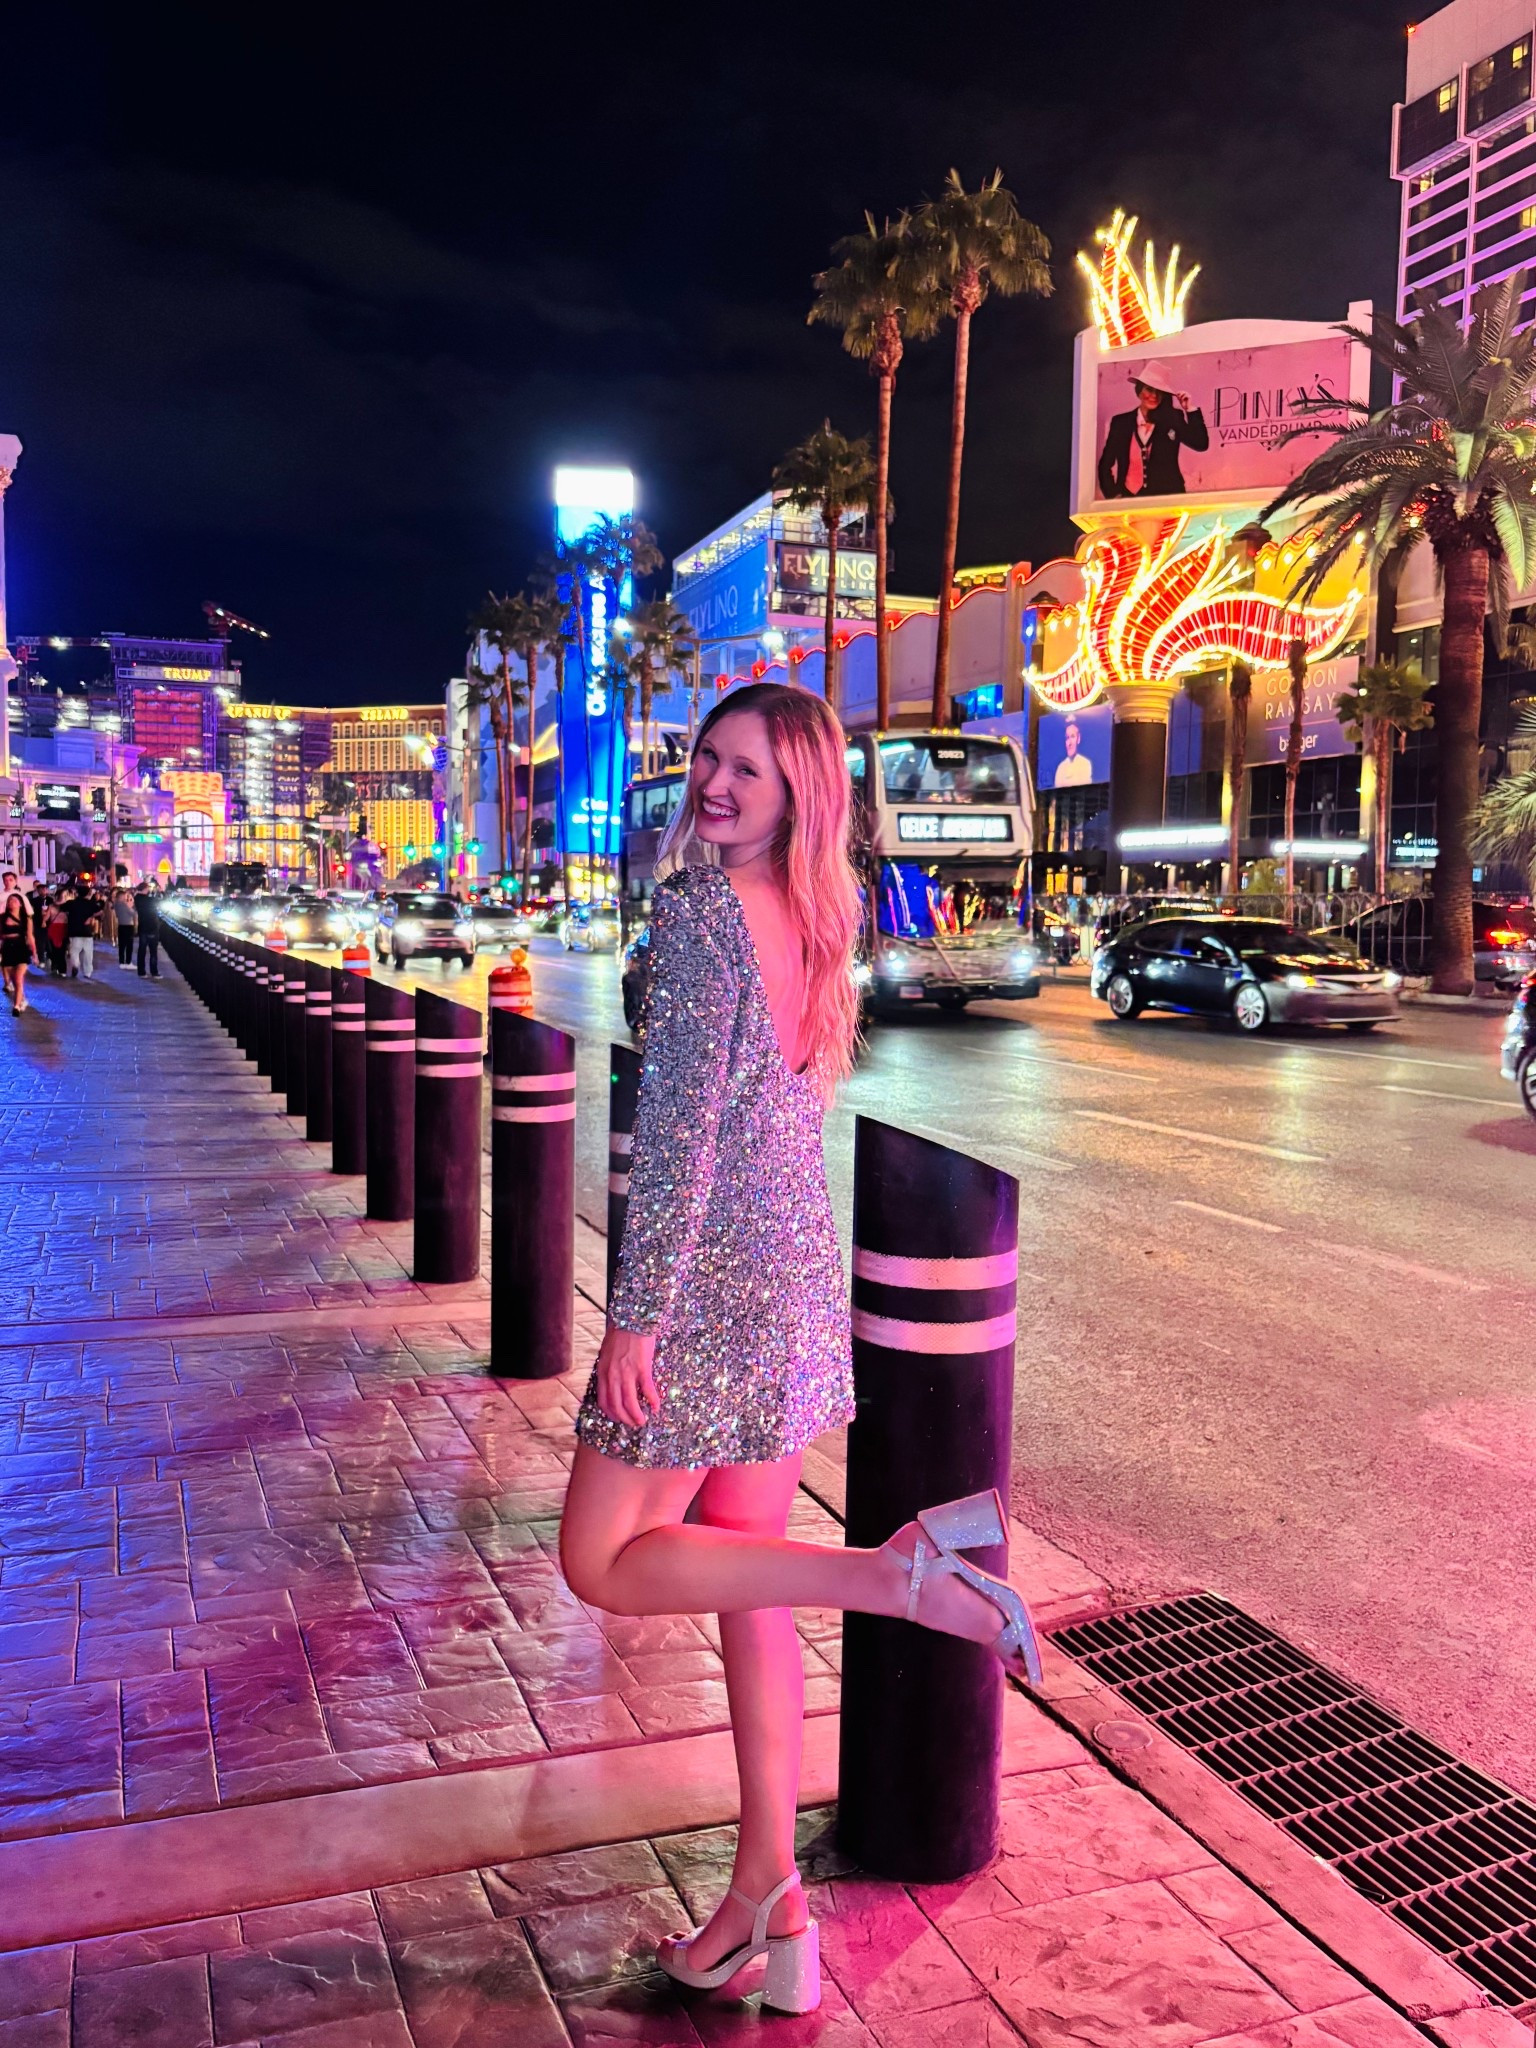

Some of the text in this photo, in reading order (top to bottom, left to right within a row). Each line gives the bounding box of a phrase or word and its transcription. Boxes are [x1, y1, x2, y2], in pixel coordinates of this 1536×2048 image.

[1211, 373, 1336, 428] PINKY'S
[783, 553, 876, 580] FLYLINQ
[811, 577, 876, 591] ZILINE
[163, 667, 212, 680] TRUMP
[1266, 667, 1337, 696] GODON
[360, 707, 409, 721] ISLAND
